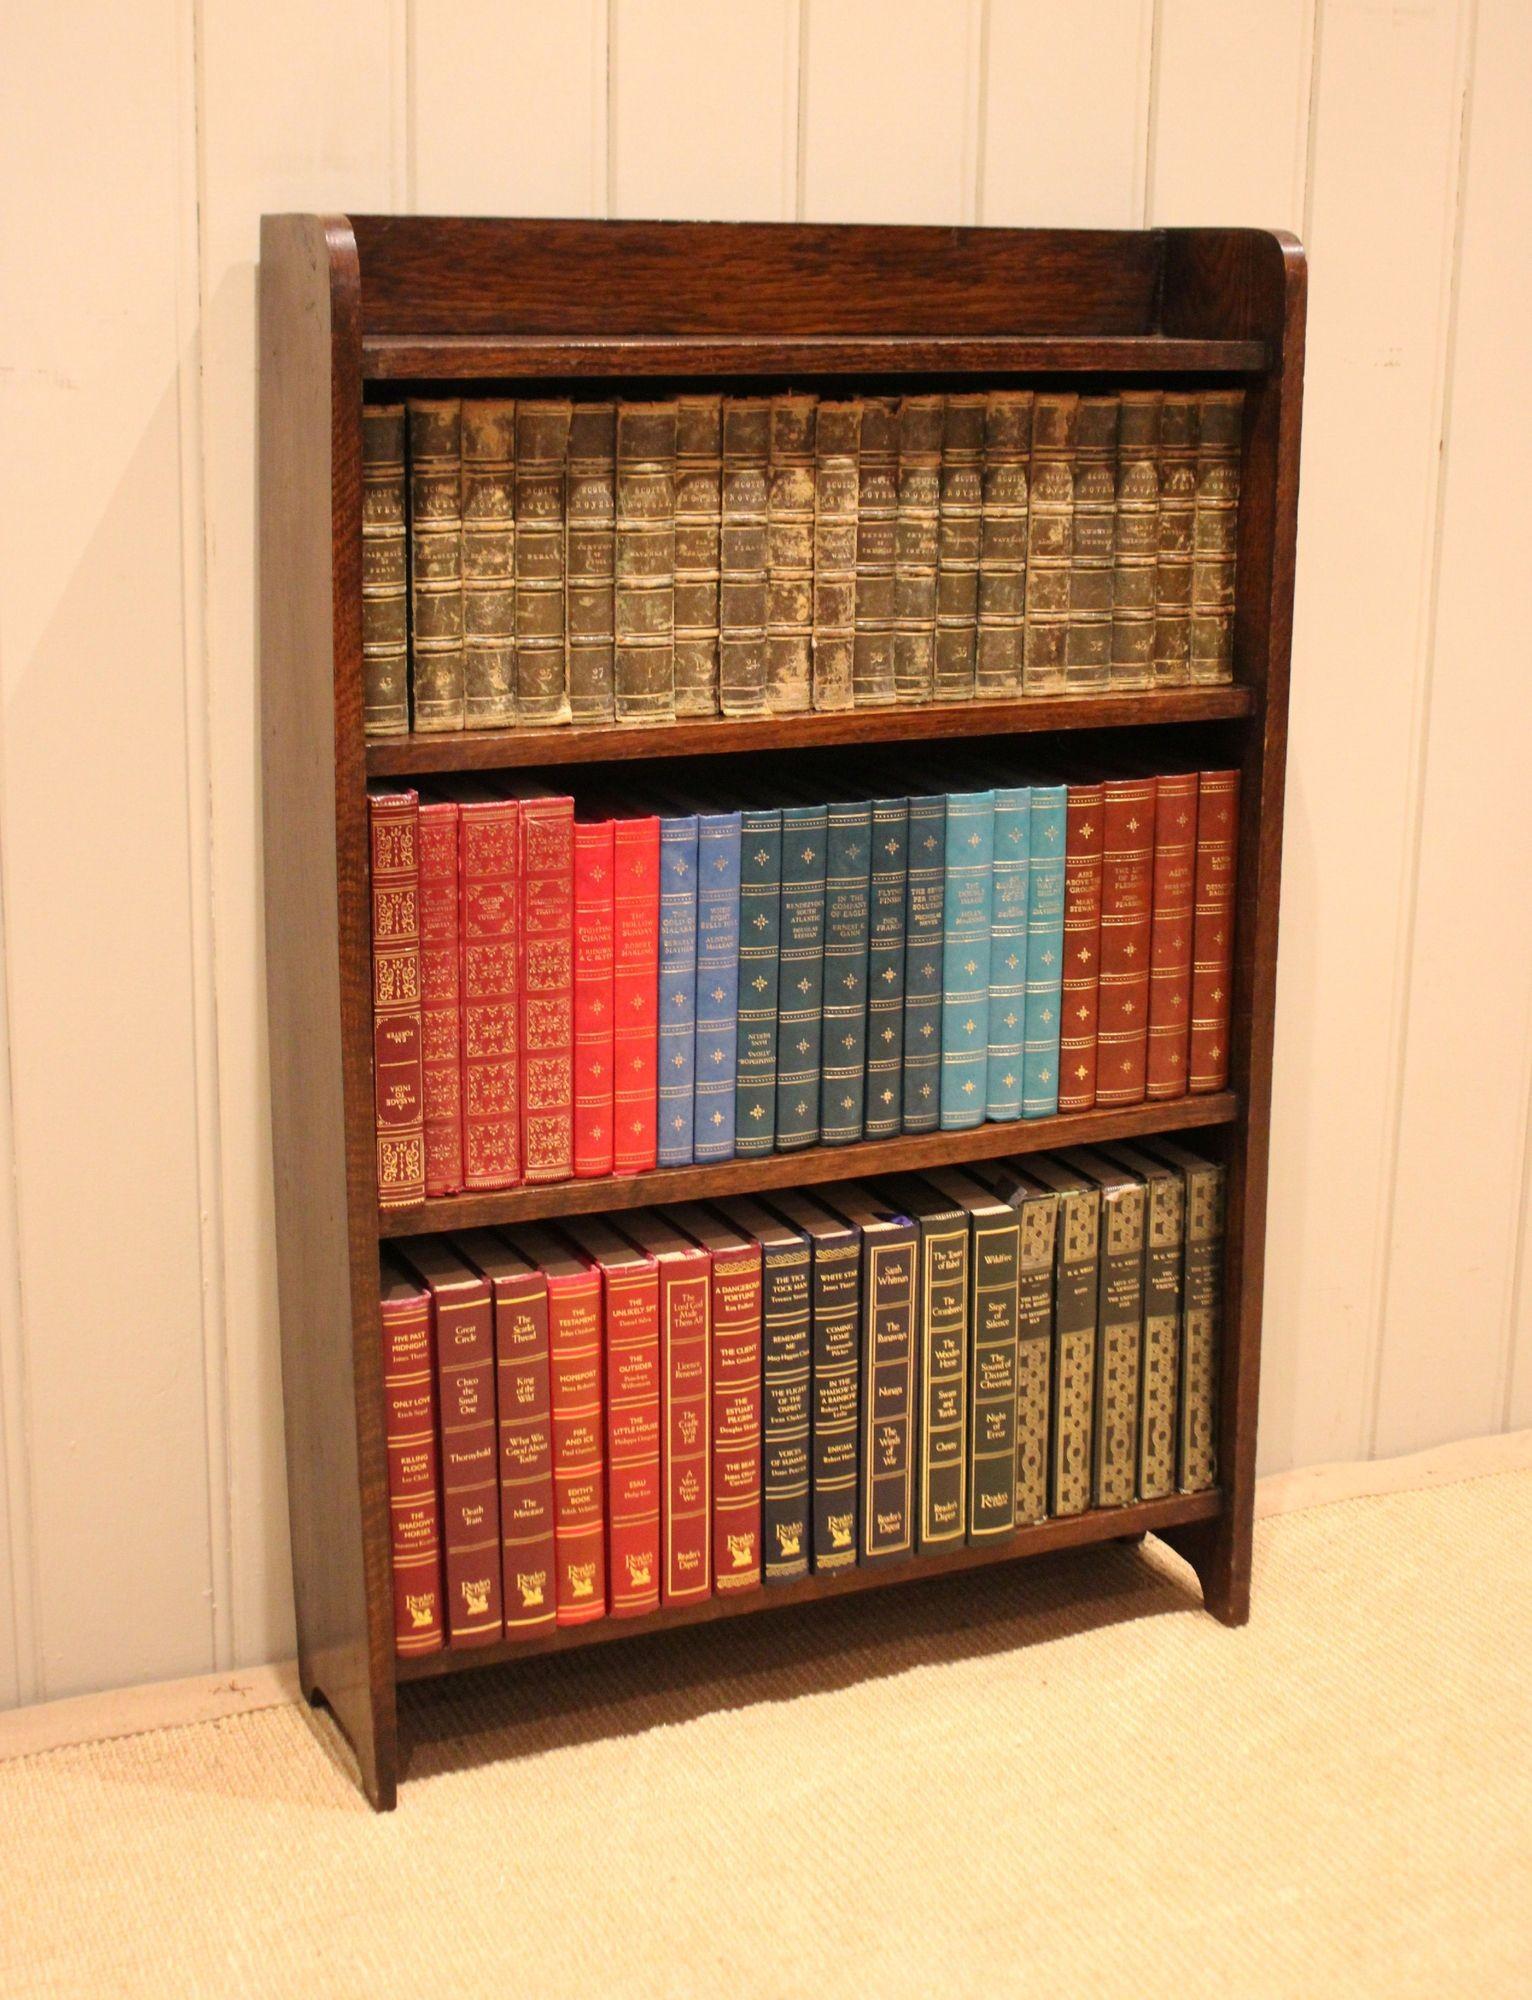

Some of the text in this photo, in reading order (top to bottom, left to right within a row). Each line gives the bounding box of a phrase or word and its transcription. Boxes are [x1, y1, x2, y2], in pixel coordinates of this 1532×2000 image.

[832, 902, 867, 910] COMPANY
[933, 1252, 947, 1261] The
[885, 1265, 903, 1275] Sarah
[776, 1274, 806, 1284] THE TICK
[820, 1273, 842, 1282] WHITE
[878, 1275, 909, 1286] Whitman
[772, 1282, 808, 1293] TOCK MAN
[682, 1294, 695, 1302] The
[724, 1291, 755, 1303] FORTUNE
[943, 1297, 955, 1306] The
[629, 1298, 642, 1307] THE
[674, 1299, 704, 1312] Lord God
[988, 1302, 1007, 1312] Siege
[572, 1308, 585, 1317] THE
[612, 1306, 645, 1317] UNLIKELY
[679, 1309, 697, 1319] Made
[517, 1315, 531, 1324] The
[559, 1314, 596, 1327] TESTAMENT
[674, 1318, 693, 1328] Them
[985, 1318, 1010, 1329] Silence
[455, 1325, 476, 1334] Great
[513, 1324, 535, 1334] Scarlet
[826, 1323, 854, 1334] COMING
[886, 1322, 900, 1331] The
[410, 1331, 425, 1340] PAST
[455, 1334, 477, 1344] Circle
[512, 1333, 536, 1344] Thread
[773, 1332, 807, 1343] REMEMBER
[830, 1333, 850, 1342] HOME
[392, 1341, 427, 1352] MIDNIGHT
[943, 1339, 955, 1349] The
[720, 1344, 757, 1356] THE CLIENT
[629, 1355, 643, 1363] THE
[990, 1354, 1005, 1363] The
[619, 1362, 652, 1373] OUTSIDER
[981, 1361, 1002, 1371] Sound
[985, 1369, 1009, 1380] Distant
[456, 1377, 478, 1387] Chico
[516, 1377, 535, 1387] King
[838, 1378, 850, 1386] THE
[980, 1378, 1012, 1390] Cheering
[463, 1387, 474, 1395] the
[516, 1387, 524, 1395] of
[771, 1385, 807, 1398] THE FLIGHT
[819, 1385, 847, 1397] SHADOW
[459, 1395, 478, 1405] Small
[517, 1393, 535, 1403] Wild
[734, 1398, 748, 1406] THE
[778, 1395, 801, 1405] OF THE
[393, 1399, 413, 1409] ONLY
[460, 1405, 476, 1414] One
[683, 1411, 696, 1420] The
[986, 1412, 1006, 1423] Night
[630, 1417, 643, 1425] THE
[678, 1419, 699, 1429] Cradle
[613, 1424, 637, 1436] LITTLE
[682, 1426, 696, 1436] Will
[884, 1427, 897, 1436] The
[993, 1423, 1001, 1431] of
[683, 1434, 696, 1444] Fall
[986, 1430, 1006, 1440] Error
[565, 1435, 594, 1446] AND ICE
[506, 1442, 548, 1457] Good About
[779, 1448, 802, 1458] VOICES
[827, 1443, 853, 1454] ENIGMA
[886, 1447, 893, 1456] of
[401, 1454, 428, 1464] KILLING
[450, 1448, 491, 1463] Thornyhold
[517, 1454, 538, 1464] Today
[726, 1463, 740, 1472] THE
[770, 1458, 781, 1467] OF
[403, 1463, 427, 1473] FLOOR
[687, 1469, 693, 1477] A
[682, 1478, 697, 1488] Very
[568, 1485, 593, 1497] EDITH'S
[679, 1485, 699, 1496] Private
[570, 1495, 591, 1505] BOOK
[682, 1493, 696, 1503] War
[522, 1499, 536, 1508] The
[462, 1505, 484, 1517] Death
[513, 1507, 544, 1519] Minotaur
[465, 1516, 482, 1526] Train
[879, 1521, 900, 1534] Digest
[677, 1550, 701, 1561] Reader's
[678, 1559, 699, 1571] Digest
